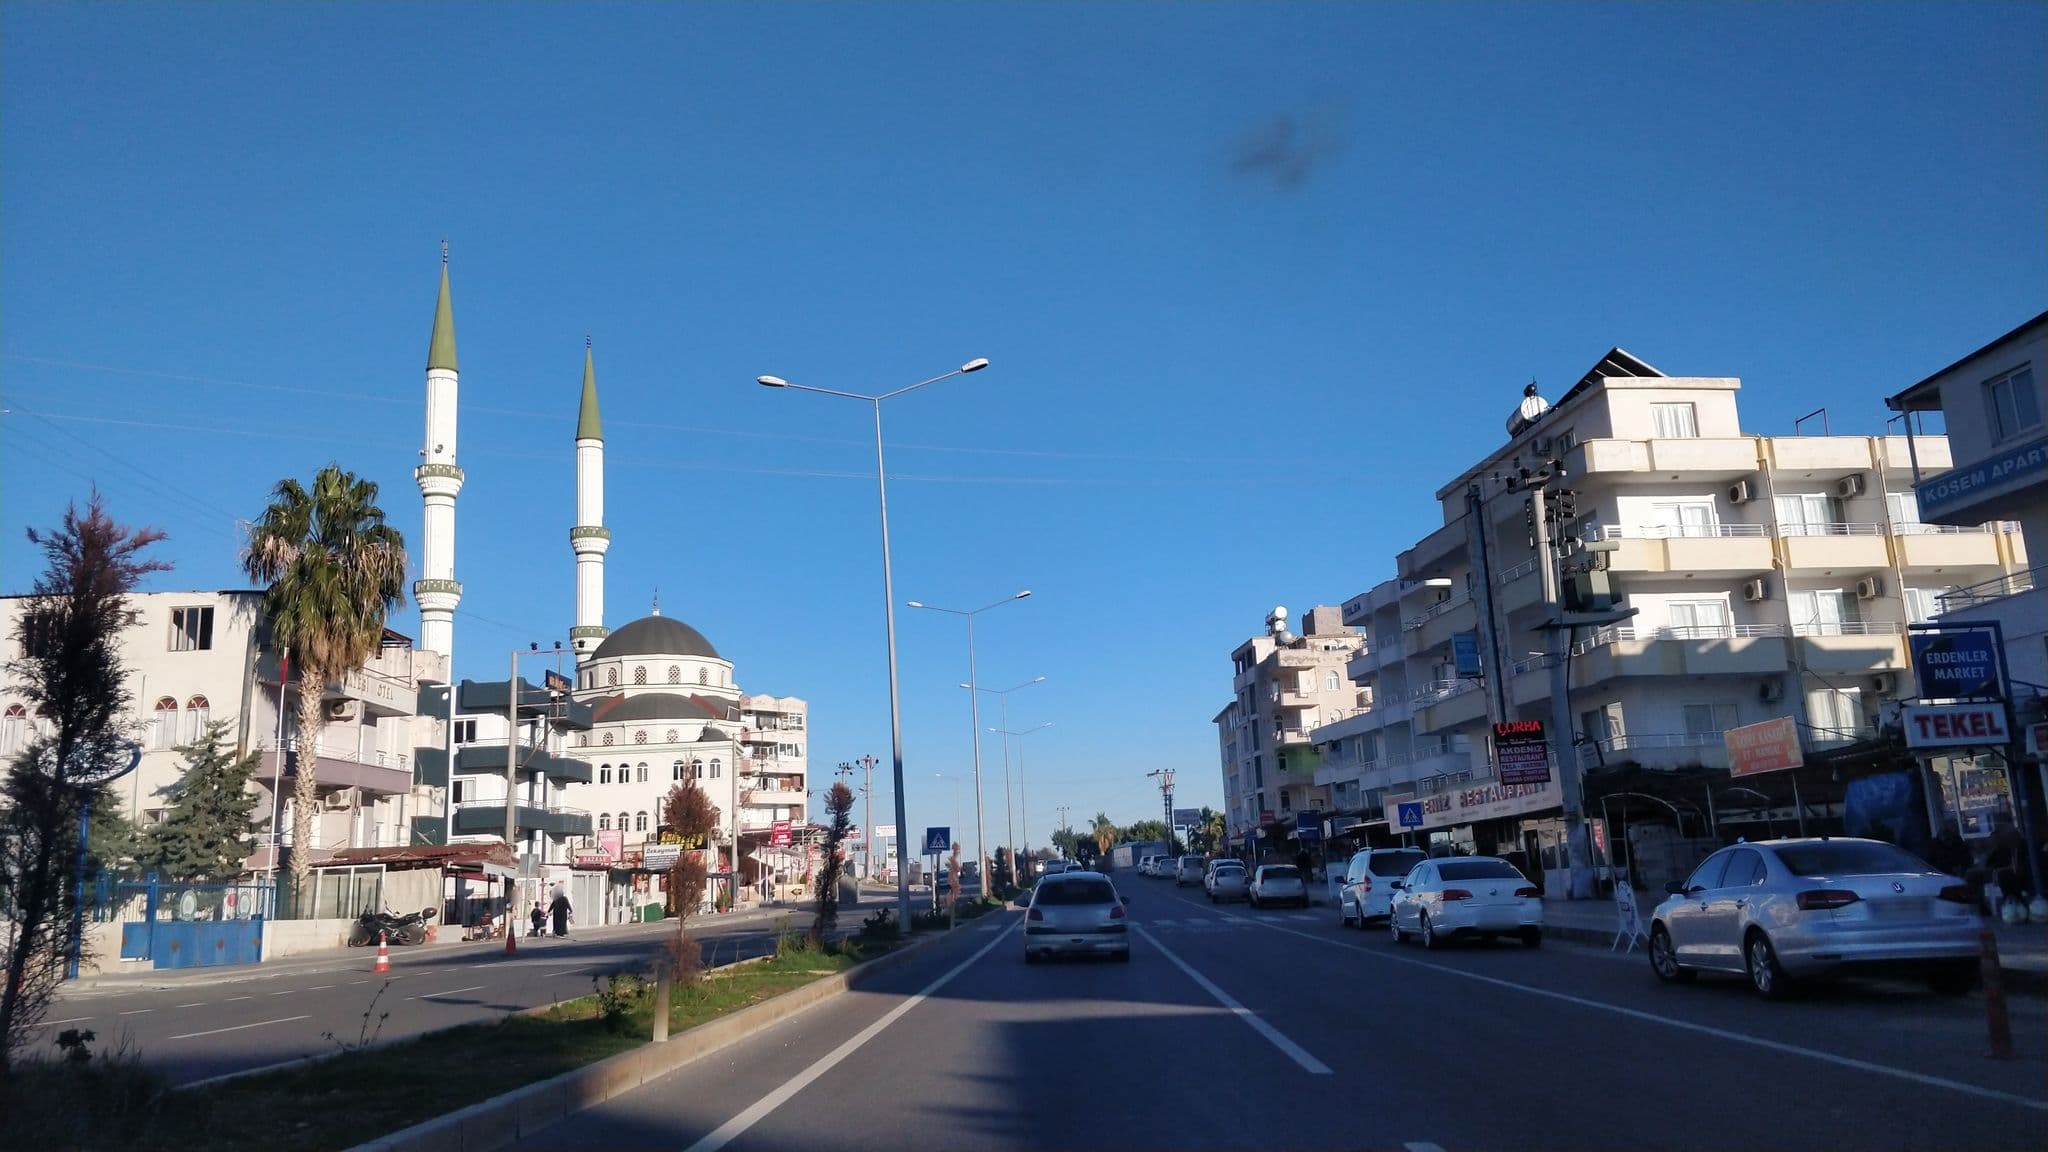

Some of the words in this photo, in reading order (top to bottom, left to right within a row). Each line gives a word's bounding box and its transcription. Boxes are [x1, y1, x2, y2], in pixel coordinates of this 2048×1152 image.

[1926, 649, 1988, 665] ERDENLER
[1934, 666, 1985, 681] MARKET
[1913, 711, 2004, 739] TEKEL
